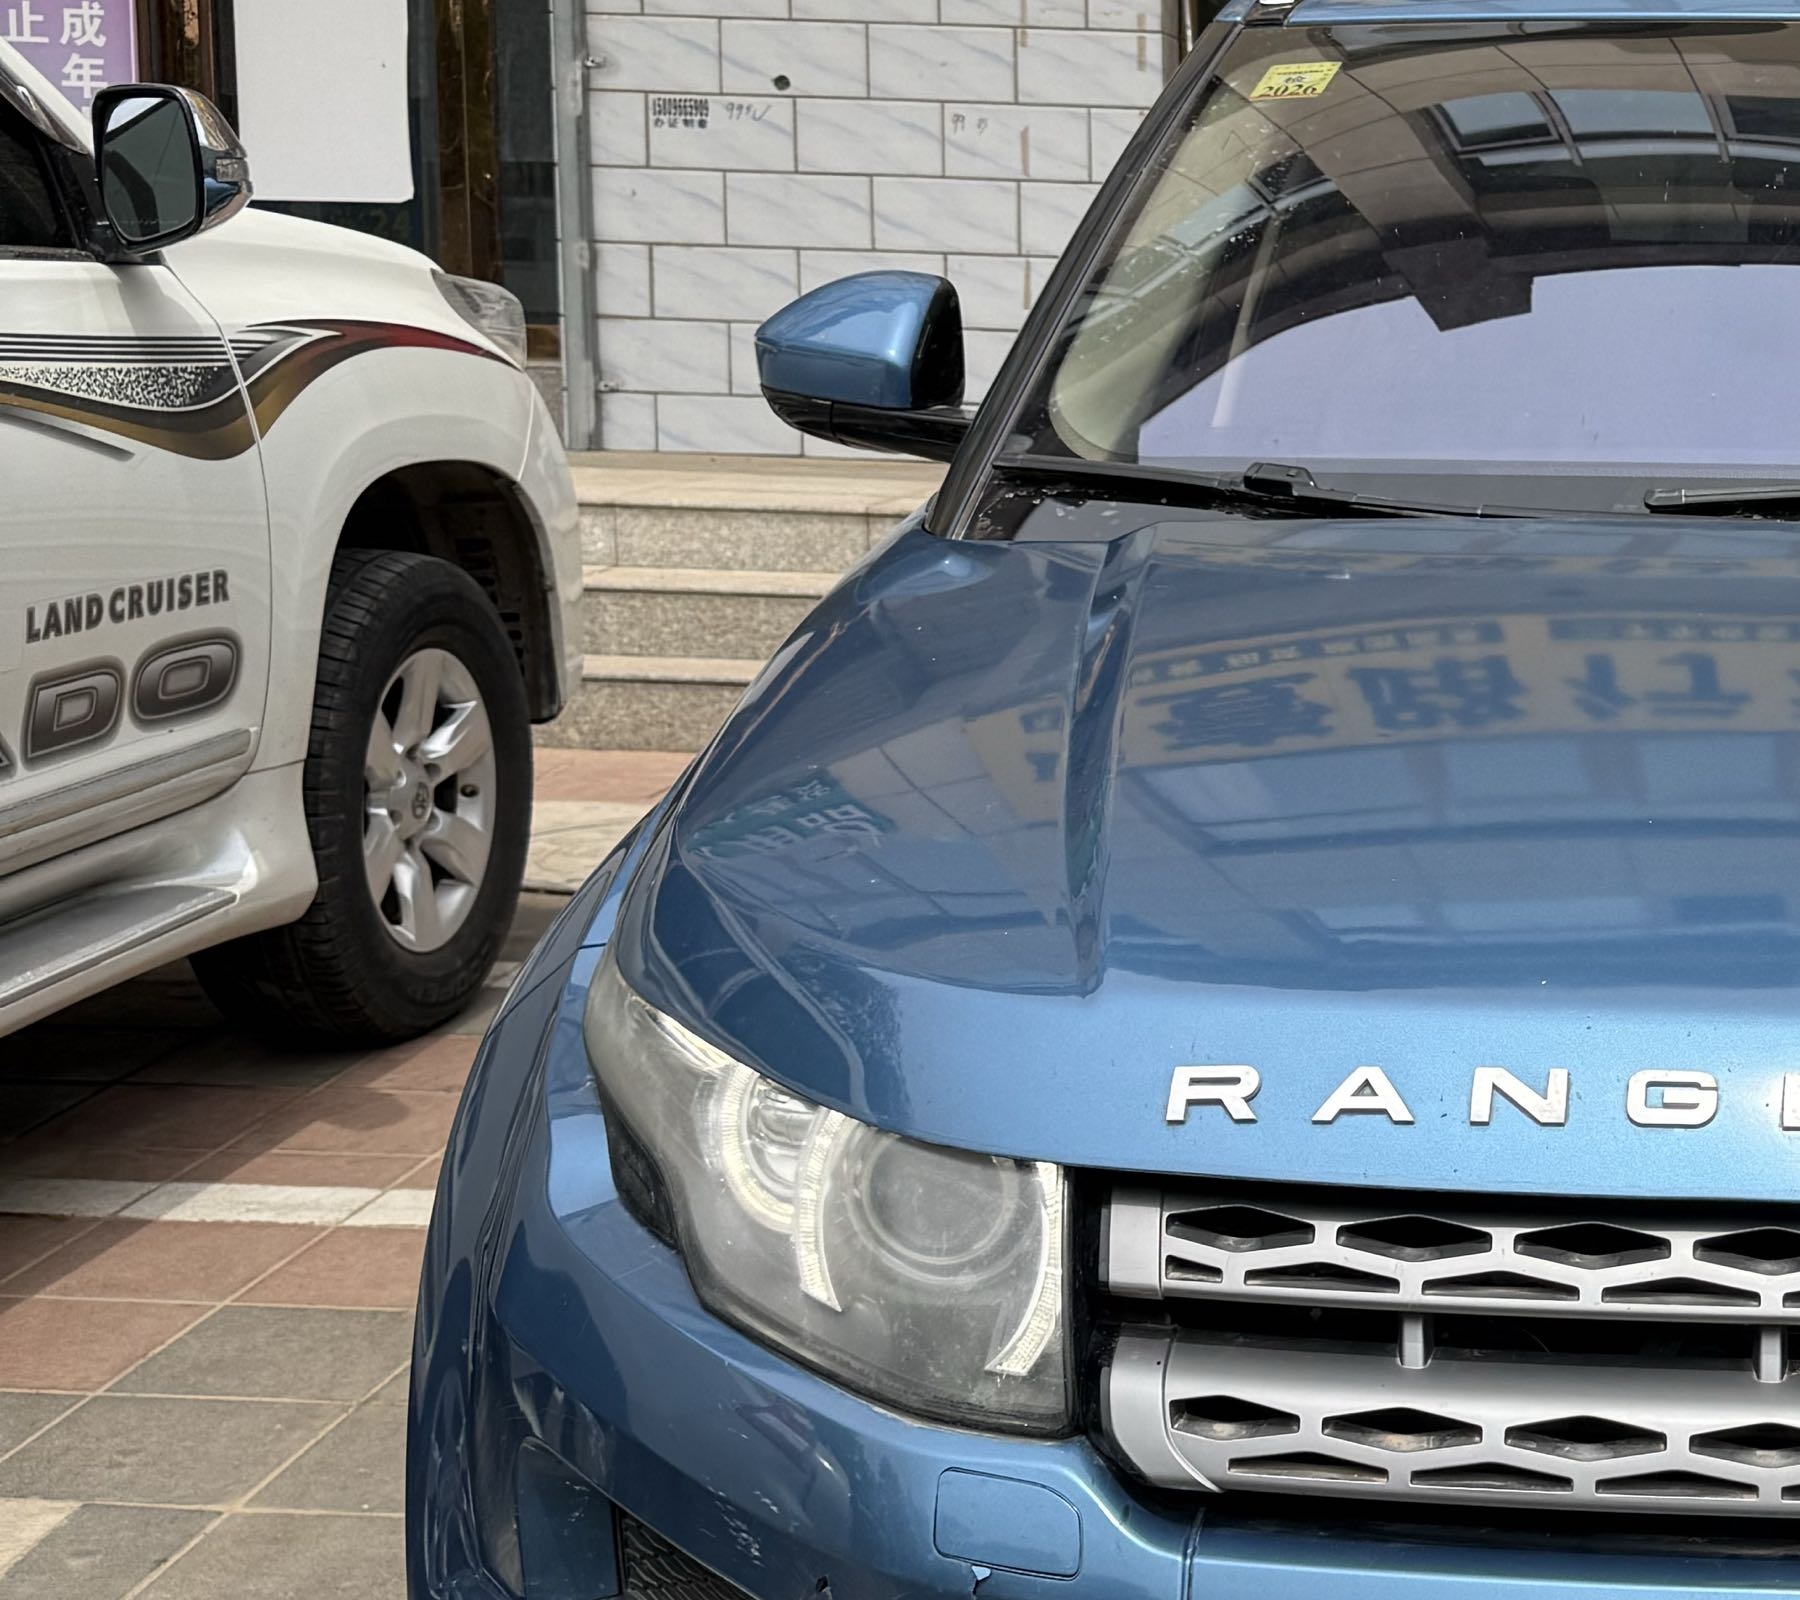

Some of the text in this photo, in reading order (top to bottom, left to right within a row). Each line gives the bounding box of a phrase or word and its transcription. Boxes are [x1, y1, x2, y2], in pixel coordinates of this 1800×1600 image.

[1259, 82, 1318, 98] 2026
[26, 568, 230, 645] LAND CRUISER
[0, 629, 243, 777] DO
